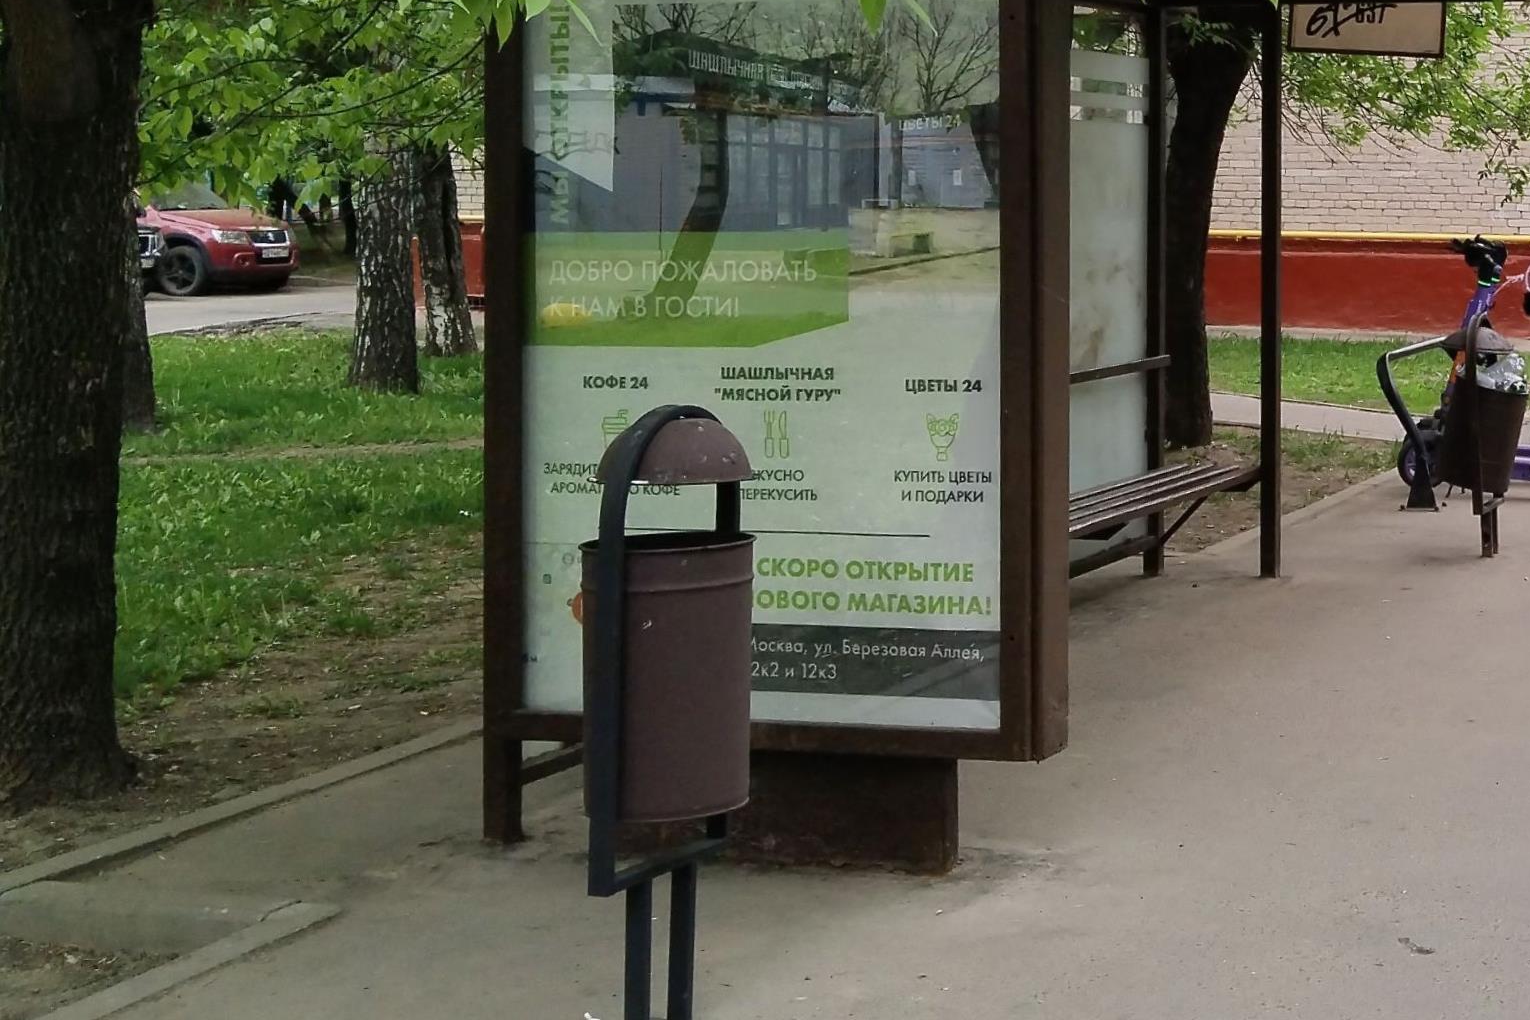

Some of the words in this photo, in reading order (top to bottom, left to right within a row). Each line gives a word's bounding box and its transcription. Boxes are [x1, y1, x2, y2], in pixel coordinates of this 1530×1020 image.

[550, 260, 633, 285] ДОБРО
[641, 260, 817, 282] ПОЖАЛОВАТЬ
[550, 296, 564, 318] К
[571, 297, 627, 318] НАМ
[634, 296, 647, 318] В
[655, 296, 739, 318] ГОСТИ!
[583, 376, 627, 390] КОФЕ
[629, 376, 649, 390] 24
[720, 366, 834, 382] ШАШЛЫЧНАЯ
[714, 384, 792, 402] "МЯСНОЙ
[795, 388, 841, 403] ГУРУ"
[905, 379, 958, 394] ЦВЕТЫ
[962, 379, 982, 392] 24
[894, 470, 945, 483] КУПИТЬ
[948, 471, 992, 485] ЦВЕТЫ
[901, 490, 912, 502] И
[915, 490, 984, 505] ПОДАРКИ
[756, 557, 839, 579] СКОРО
[845, 560, 974, 582] ОТКРЫТИЕ
[755, 589, 840, 611] ОВОГО
[847, 593, 992, 616] МАГАЗИНА!
[814, 644, 837, 658] ул.
[842, 638, 926, 660] Березовая
[785, 667, 795, 678] и
[802, 662, 837, 679] 12к3
